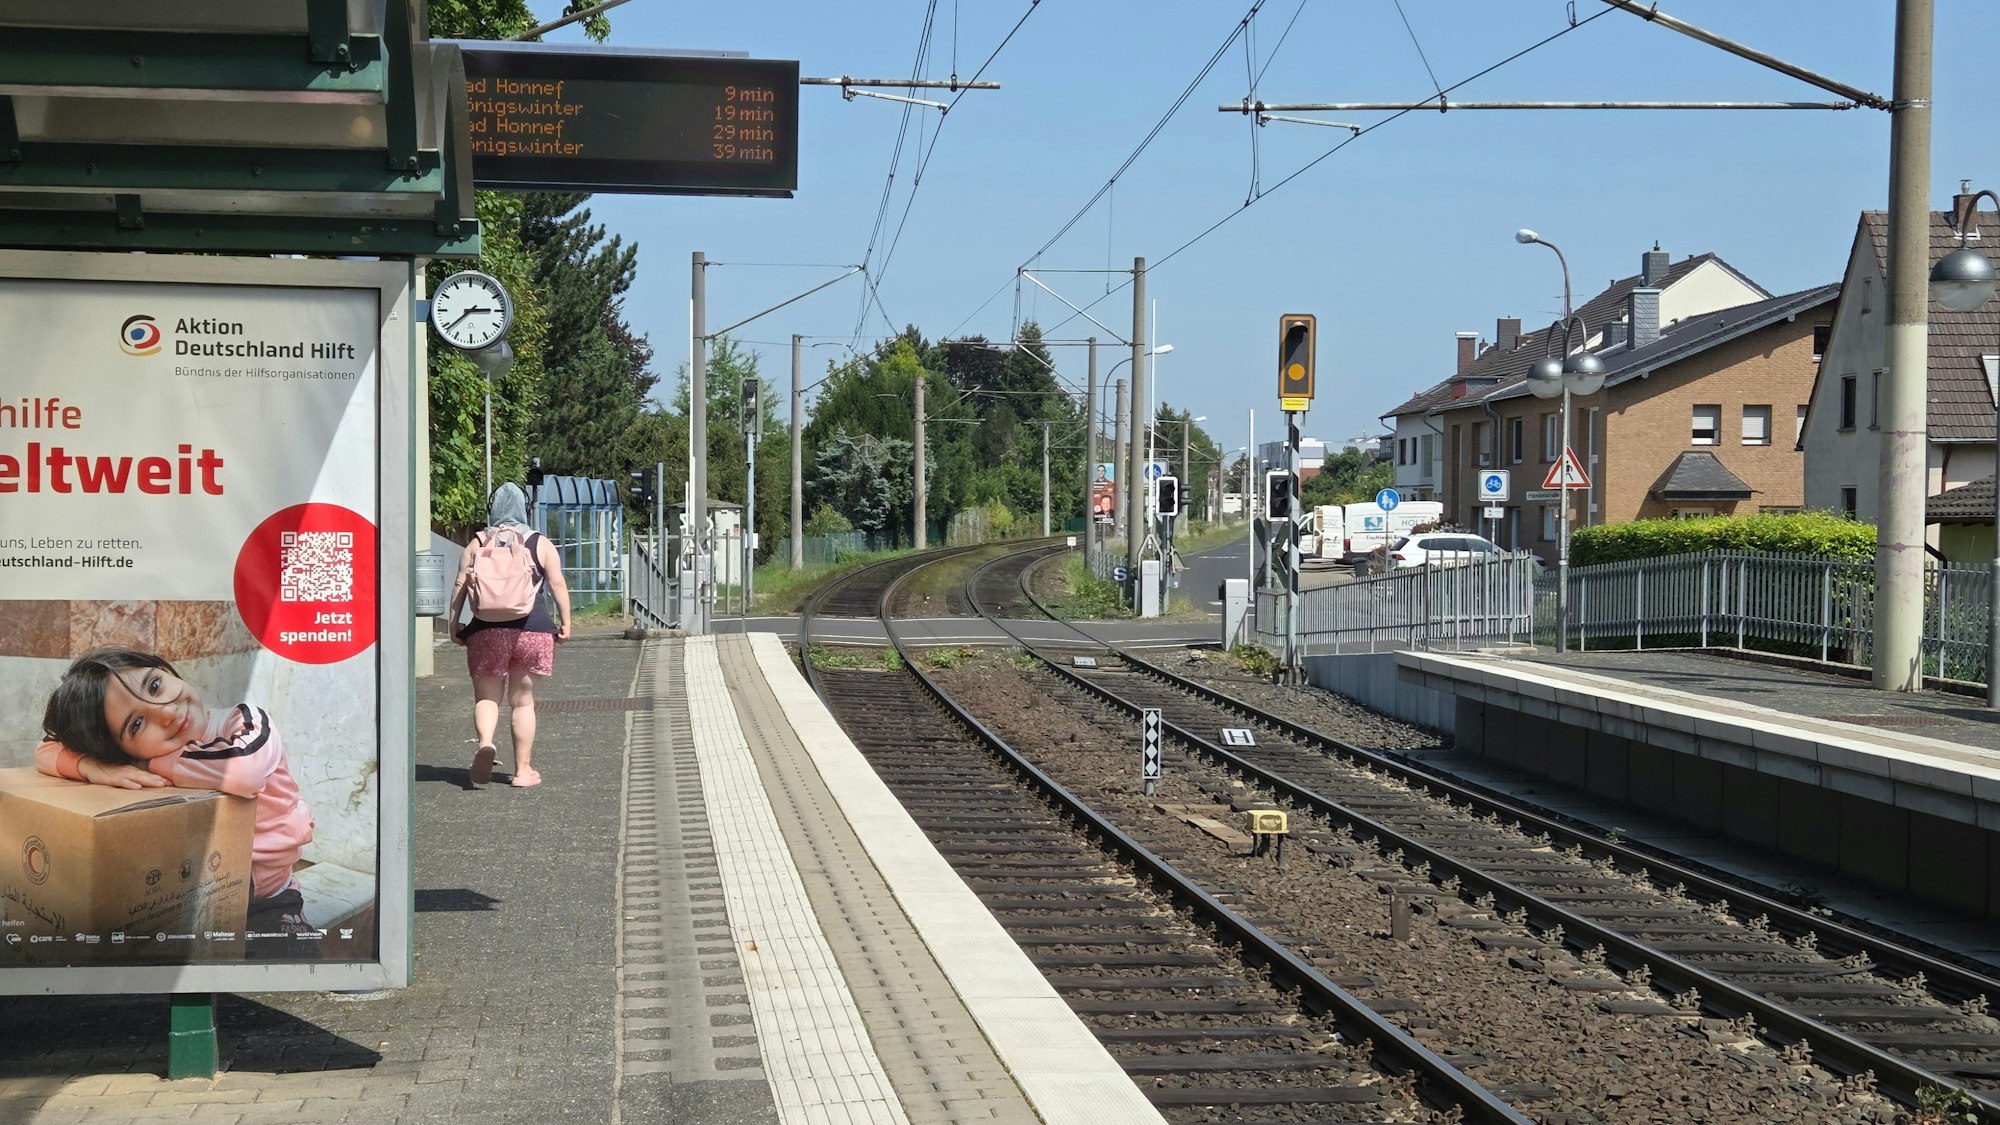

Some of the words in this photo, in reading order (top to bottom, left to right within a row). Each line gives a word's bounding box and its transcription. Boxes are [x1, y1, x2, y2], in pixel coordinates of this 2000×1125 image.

[496, 78, 565, 99] Honnef
[725, 86, 736, 101] 9
[740, 87, 775, 102] min
[715, 105, 736, 121] 19
[740, 106, 775, 122] min
[496, 117, 565, 138] Honnef
[713, 125, 736, 140] 29
[740, 126, 774, 142] min
[713, 144, 736, 159] 39
[740, 145, 774, 161] min
[175, 317, 244, 335] Aktion
[175, 340, 304, 358] Deutschland
[311, 342, 355, 360] Hilft
[175, 366, 222, 377] Bündnis
[224, 367, 242, 378] der
[246, 368, 355, 381] Hilfsorganisationen
[0, 397, 82, 429] hilfe
[0, 442, 224, 496] eltweit
[0, 539, 27, 550] uns,
[31, 537, 73, 549] Leben
[76, 539, 93, 549] zu
[97, 538, 142, 550] retten.
[0, 555, 133, 568] utschland-Hilft.de
[1113, 567, 1128, 582] S
[314, 611, 353, 625] Jetzt
[280, 629, 352, 646] spenden!
[1227, 730, 1250, 744] H
[1, 919, 25, 927] helfen
